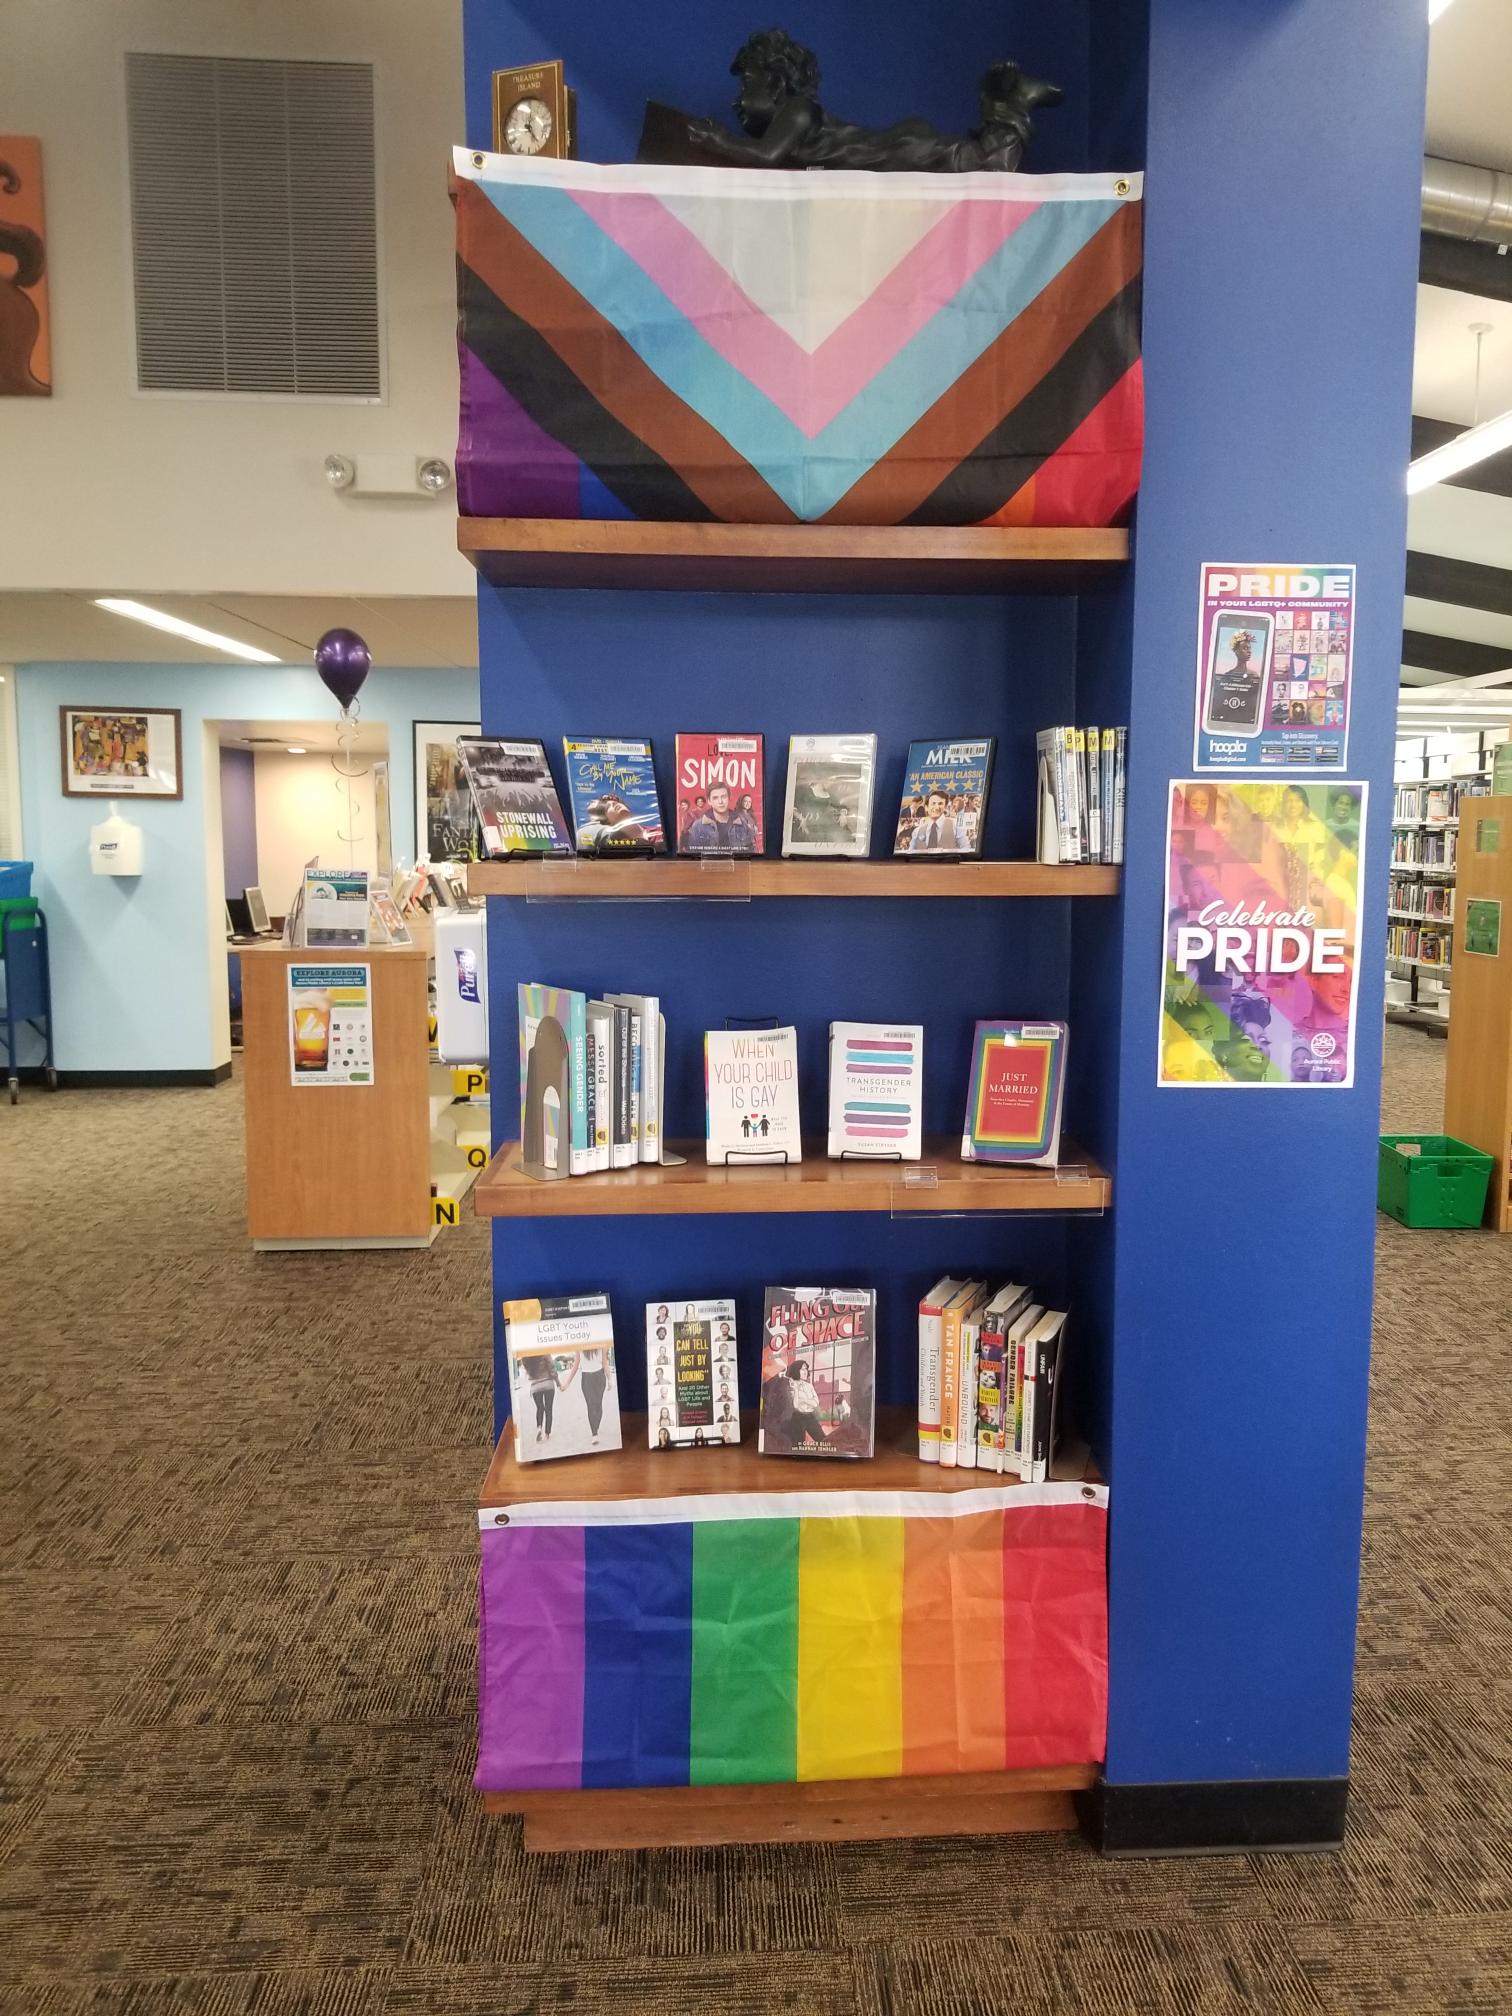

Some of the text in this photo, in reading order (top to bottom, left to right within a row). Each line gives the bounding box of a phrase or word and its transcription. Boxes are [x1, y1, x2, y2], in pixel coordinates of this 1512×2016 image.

[517, 81, 541, 93] ISLAND
[1208, 573, 1351, 598] PRIDE
[1209, 739, 1247, 755] hoopla
[681, 757, 756, 789] SIMON
[920, 770, 955, 780] AMERICAN
[955, 770, 984, 779] CLASSIC
[496, 811, 554, 825] STONEWALL
[499, 824, 557, 840] UPRISING
[1198, 899, 1317, 928] Celebrate
[1175, 927, 1347, 974] PRIDE
[732, 1039, 775, 1059] WHEN
[575, 1036, 584, 1113] SEEING GENDER
[586, 1038, 595, 1112] MESSY GRACE
[714, 1060, 793, 1084] YOUR CHILD
[846, 1077, 912, 1087] TRANSGENDER
[1001, 1072, 1028, 1082] JUST
[467, 1074, 483, 1093] P
[859, 1086, 898, 1094] HISTORY
[988, 1083, 1039, 1095] MARRIED
[731, 1085, 778, 1108] IS GAY
[468, 1148, 487, 1168] Q
[436, 1203, 455, 1224] N
[770, 1298, 830, 1328] FLUNG
[537, 1319, 589, 1333] LGBT Youth
[769, 1328, 797, 1352] OF
[801, 1311, 866, 1346] SPACE
[564, 1331, 591, 1343] Today
[676, 1339, 709, 1351] CAN TELL
[680, 1354, 706, 1367] JUST BY
[944, 1324, 955, 1399] TAN FRANCE
[1009, 1340, 1017, 1370] GENDER
[926, 1346, 939, 1412] Transgender
[1008, 1373, 1016, 1405] FAILURE
[960, 1380, 969, 1425] UNBOUND
